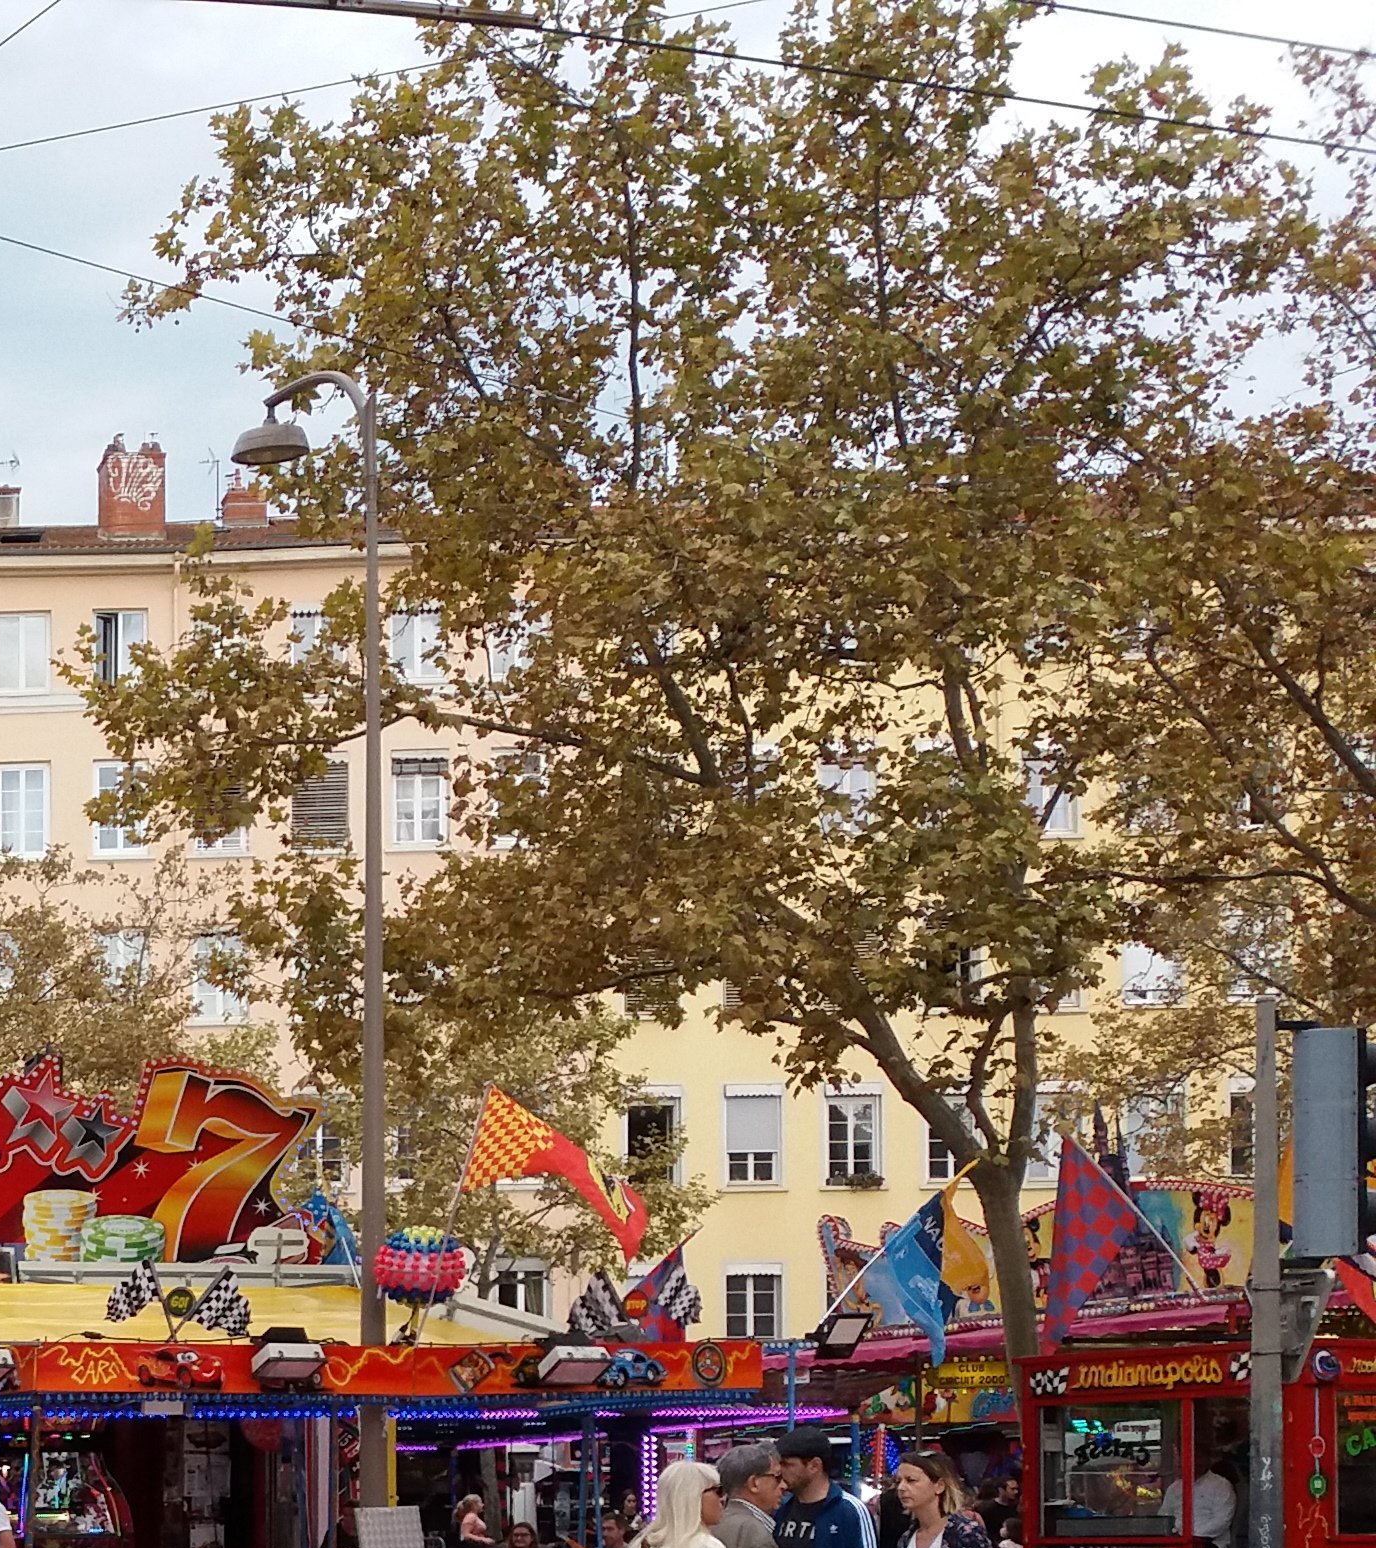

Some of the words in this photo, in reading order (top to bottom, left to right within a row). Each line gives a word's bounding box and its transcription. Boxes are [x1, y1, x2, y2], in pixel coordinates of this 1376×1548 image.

[625, 1299, 647, 1311] STOP
[71, 1359, 120, 1385] CARS
[958, 1364, 986, 1373] CLUB
[939, 1376, 975, 1386] CIRCUIT
[978, 1375, 1006, 1385] 2000
